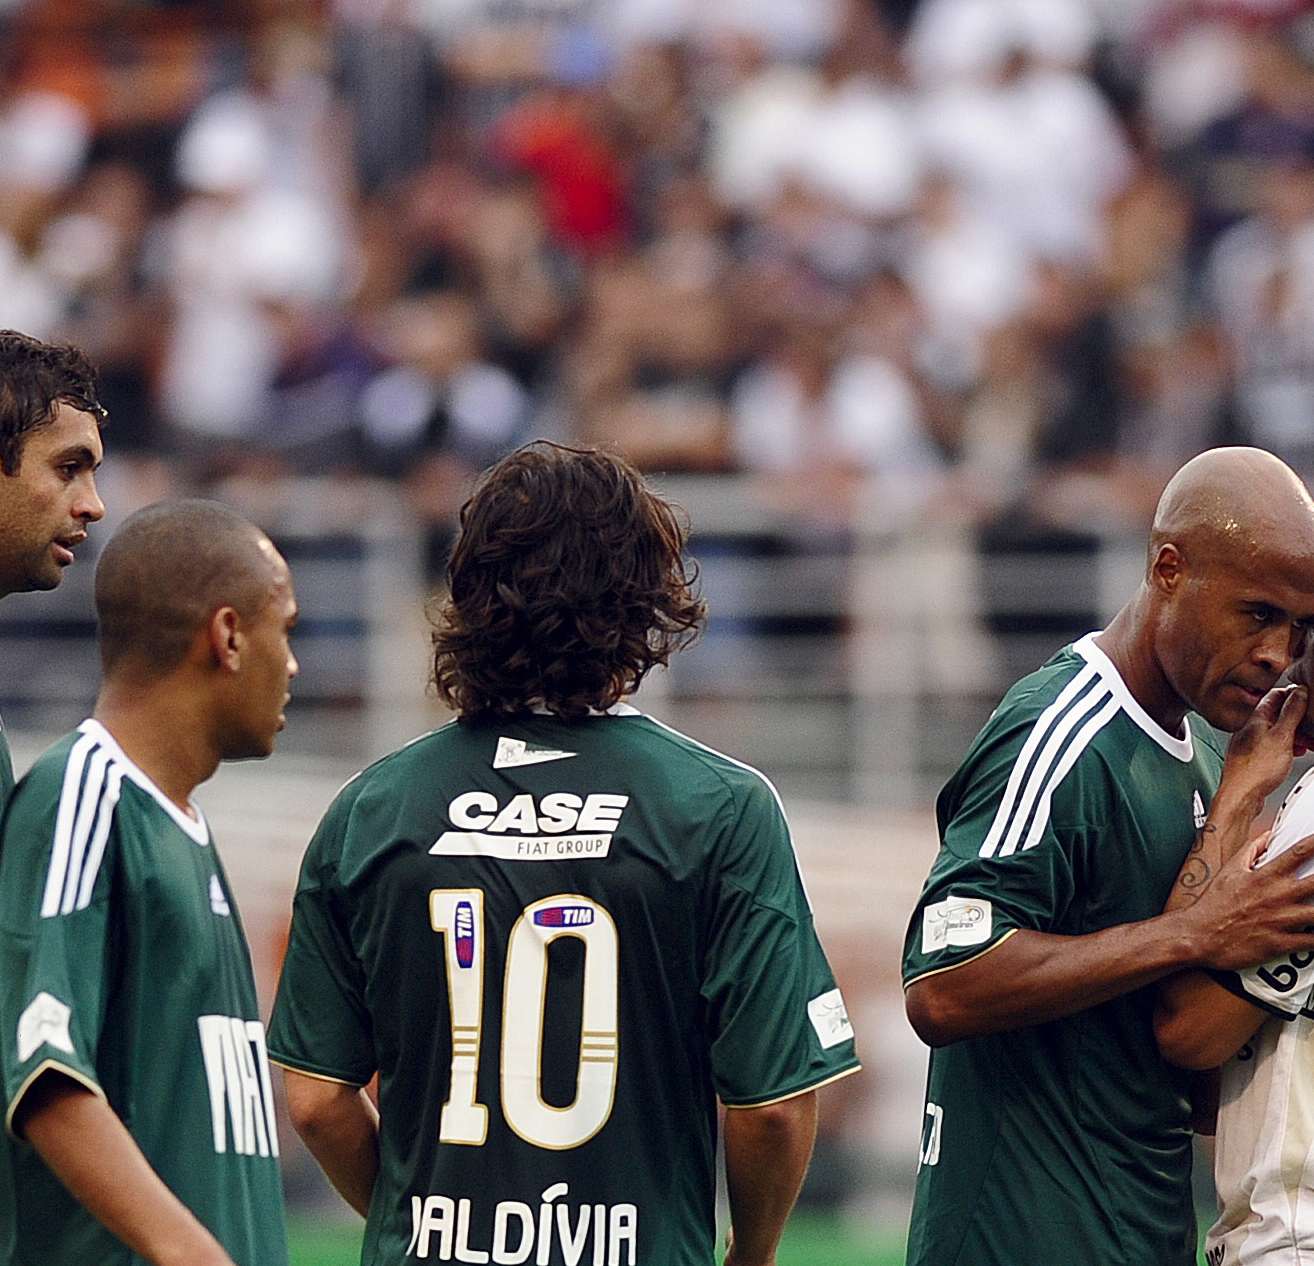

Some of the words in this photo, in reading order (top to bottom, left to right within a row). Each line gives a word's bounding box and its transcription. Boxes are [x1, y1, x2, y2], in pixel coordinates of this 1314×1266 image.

[448, 791, 630, 834] CASE
[517, 841, 549, 855] FIAT
[556, 839, 603, 854] GROUP
[457, 907, 473, 938] TIM
[563, 909, 593, 925] TIM
[429, 888, 620, 1150] 10
